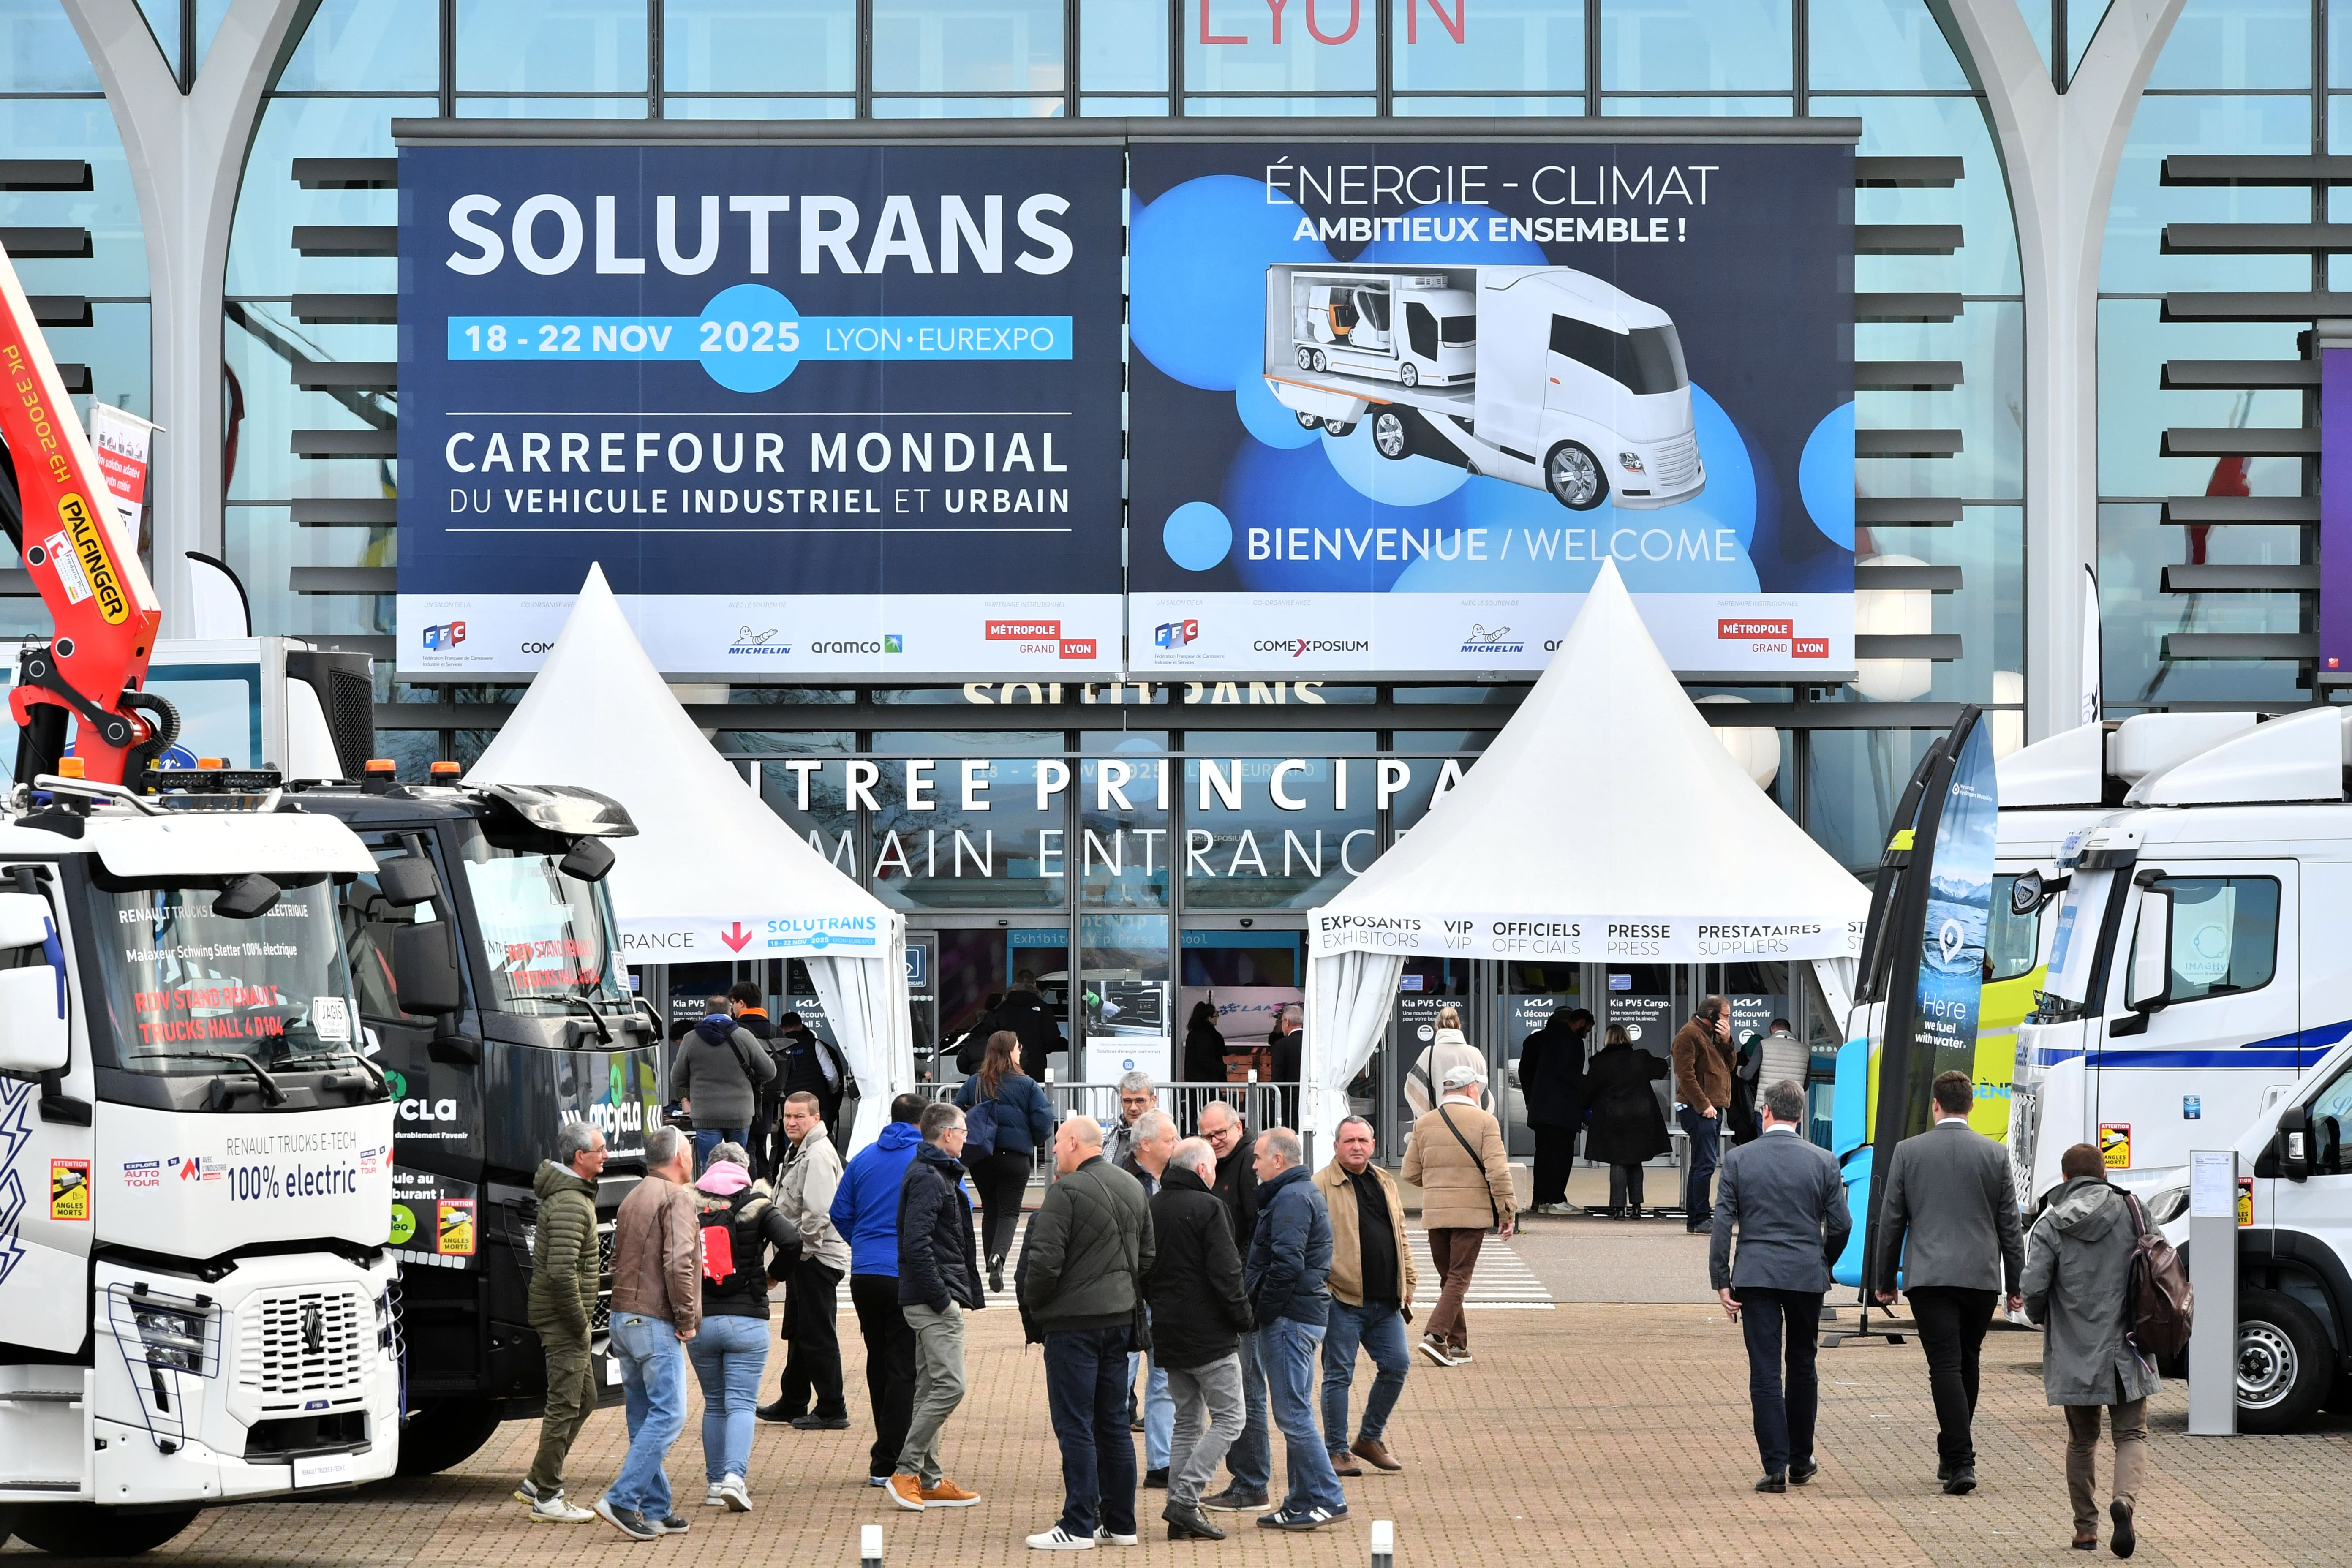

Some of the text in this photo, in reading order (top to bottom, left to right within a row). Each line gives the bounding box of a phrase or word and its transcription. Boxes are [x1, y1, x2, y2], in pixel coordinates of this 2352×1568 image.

[1267, 157, 1719, 206] ÉNERGIE CLIMAT
[446, 194, 1073, 275] SOLUTRANS
[1293, 217, 1687, 242] AMBITIEUX ENSEMBLE !
[465, 326, 507, 351] 18
[539, 325, 581, 351] 22
[593, 325, 672, 351] NOV
[700, 321, 800, 352] 2025
[3, 344, 26, 376] PK
[445, 432, 1067, 473] CARREFOUR MONDIAL
[450, 489, 1068, 513] DU VEHICULE INDUSTRIEL ET URBAIN
[1248, 528, 1736, 562] BIENVENUE WELCOME
[63, 501, 123, 618] PALFINGER
[65, 554, 78, 580] Frédéric
[426, 625, 464, 644] FFC
[991, 624, 1055, 635] MÉTROPOLE
[1158, 623, 1197, 641] FFC
[1723, 623, 1788, 634] MÉTROPOLE
[811, 642, 881, 653] aramco
[1020, 644, 1091, 653] GRAND LYON
[1253, 639, 1368, 657] COMEXPOSIUM
[1753, 643, 1824, 653] GRAND LYON
[751, 759, 1463, 811] TREE PRINCIPA
[808, 829, 1411, 878] MAIN ENTRANC
[118, 906, 170, 923] RENAULT
[172, 906, 208, 919] TRUCKS
[768, 916, 876, 933] SOLUTRANS
[1321, 915, 1821, 939] EXPOSANTS VIP OFFICIELS PRESSE PRESTATAIRES
[534, 939, 564, 958] STAND
[1014, 933, 1069, 944] Exhibit
[1323, 930, 1788, 956] EXHIBITORS VIP OFFICIALS PRESS SUPPLIERS
[127, 941, 297, 963] Malaxeur Schwing Stetter 100% électrique
[513, 968, 558, 989] TRUCKS
[558, 967, 580, 985] HALL
[134, 985, 279, 1013] RDV STAND RENAULT
[673, 999, 705, 1007] Kia PV5
[1436, 999, 1463, 1009] Cargo.
[1644, 999, 1671, 1009] Cargo.
[1923, 991, 1966, 1019] Here
[1515, 1008, 1522, 1018] À
[1732, 1010, 1771, 1018] découvrir
[139, 1016, 284, 1044] TRUCKS HALL 4 D104
[1925, 1021, 1956, 1034] we fuel
[1915, 1032, 1933, 1044] with
[227, 1131, 357, 1156] RENAULT TRUCKS E-TECH
[228, 1160, 356, 1201] 100% electric
[417, 1174, 434, 1184] au
[440, 1189, 444, 1199] !
